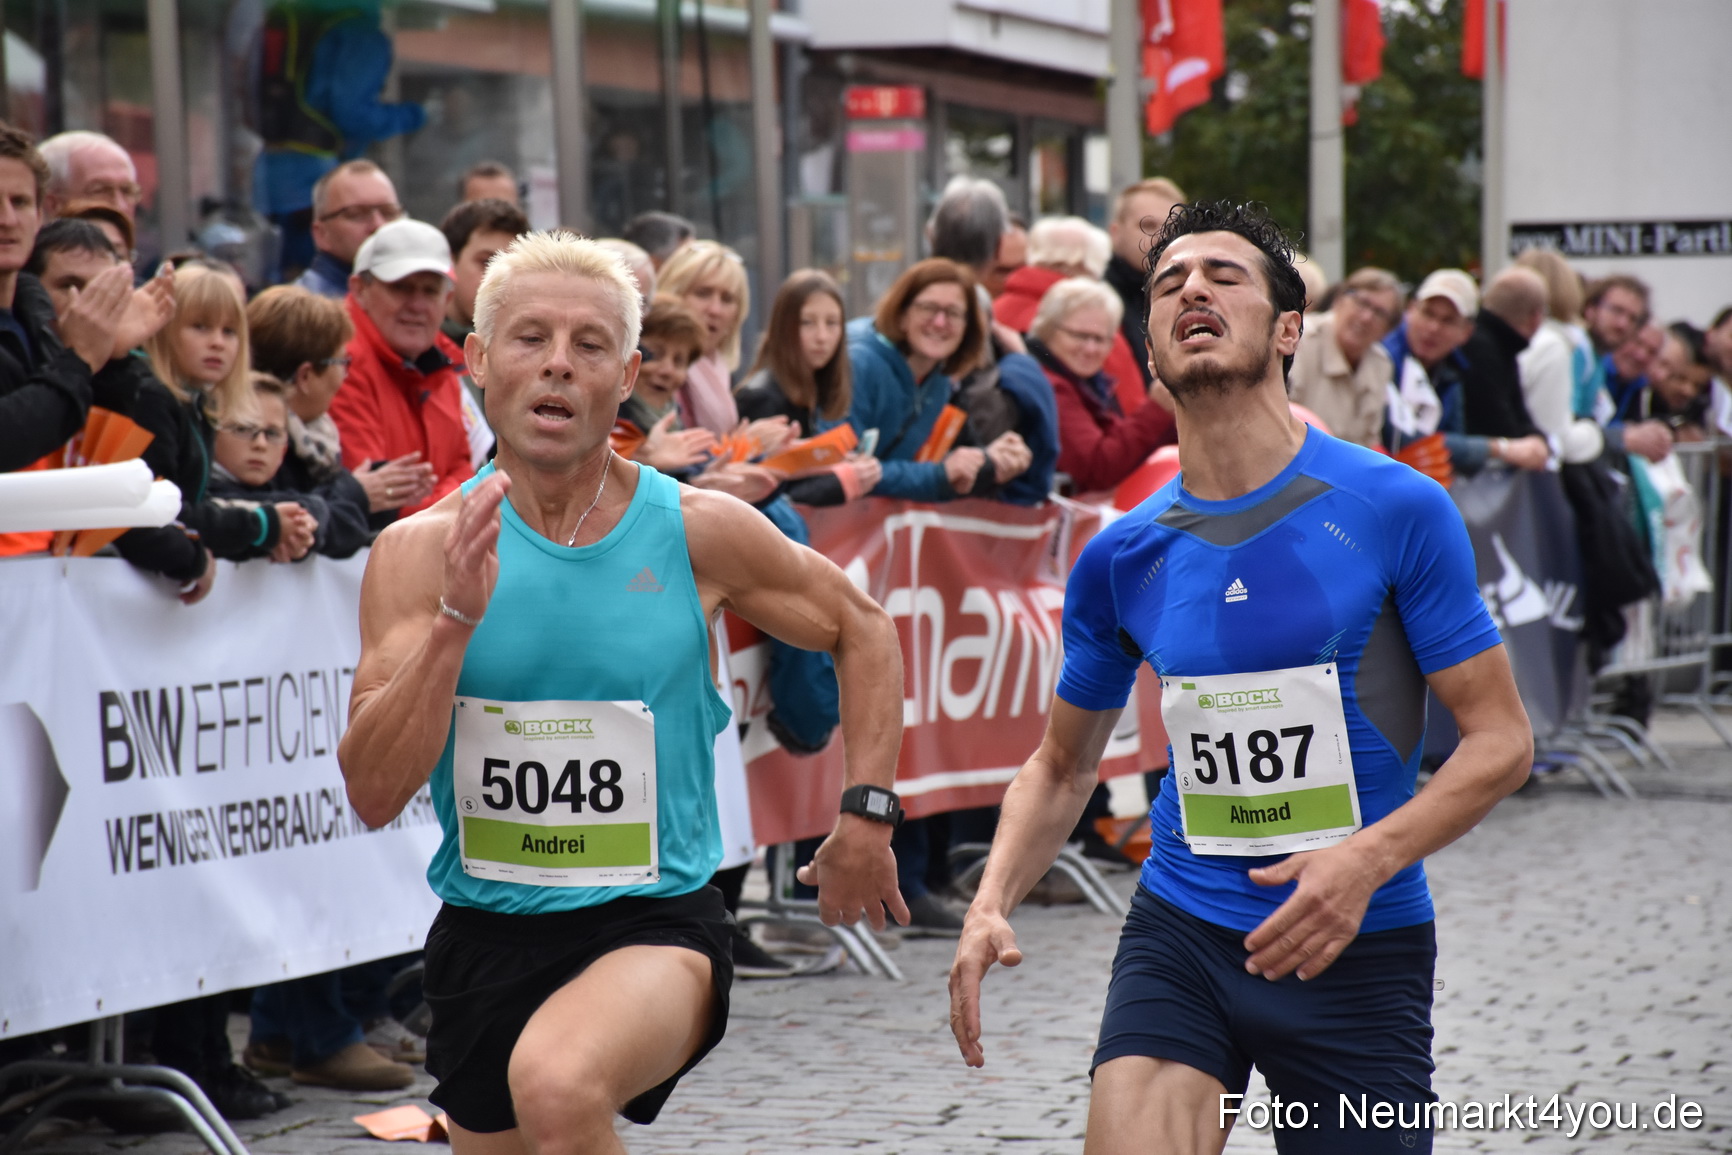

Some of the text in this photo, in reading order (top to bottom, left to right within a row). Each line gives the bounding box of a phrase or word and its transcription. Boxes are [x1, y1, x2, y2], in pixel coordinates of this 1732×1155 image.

[1216, 688, 1281, 708] BOCK
[192, 668, 357, 773] EFFICIEN
[523, 719, 594, 735] BOCK
[1190, 724, 1314, 785] 5187
[482, 757, 624, 814] 5048
[1183, 776, 1189, 786] S
[465, 801, 473, 810] S
[1230, 802, 1291, 824] Ahmad
[521, 834, 585, 854] Andrei
